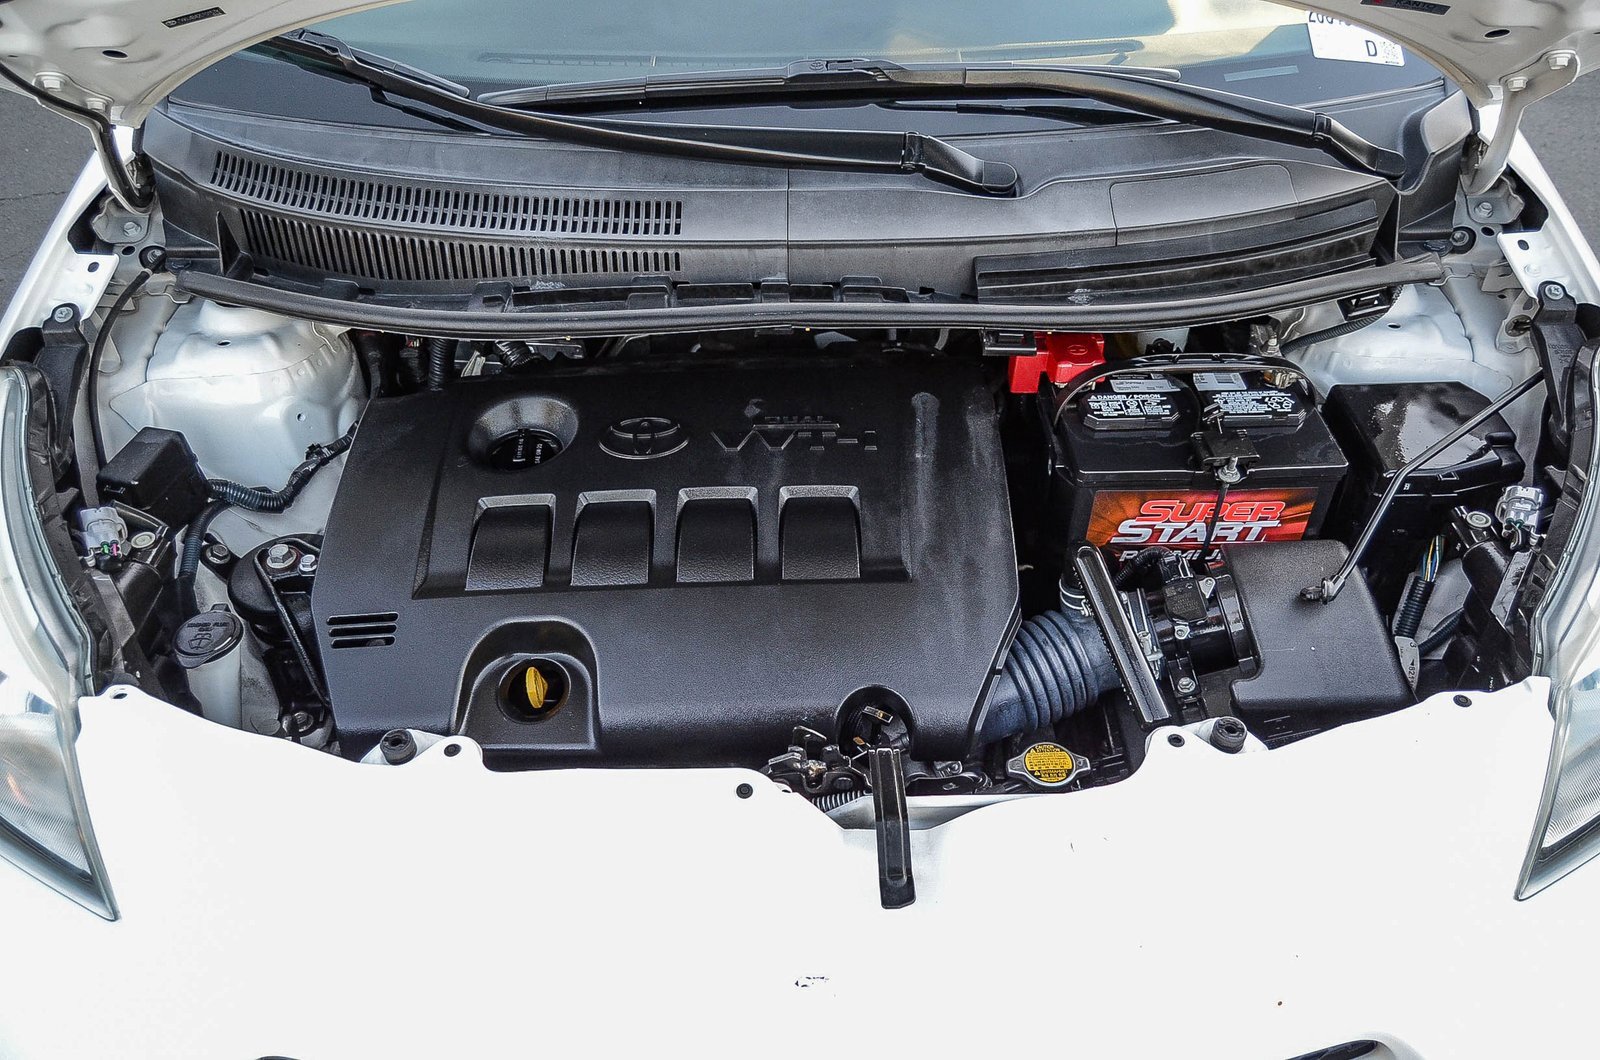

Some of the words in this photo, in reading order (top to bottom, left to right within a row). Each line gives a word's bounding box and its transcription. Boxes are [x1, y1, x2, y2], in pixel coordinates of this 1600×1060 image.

[1365, 40, 1377, 56] D
[1135, 499, 1286, 523] SUPER
[1110, 520, 1279, 544] START
